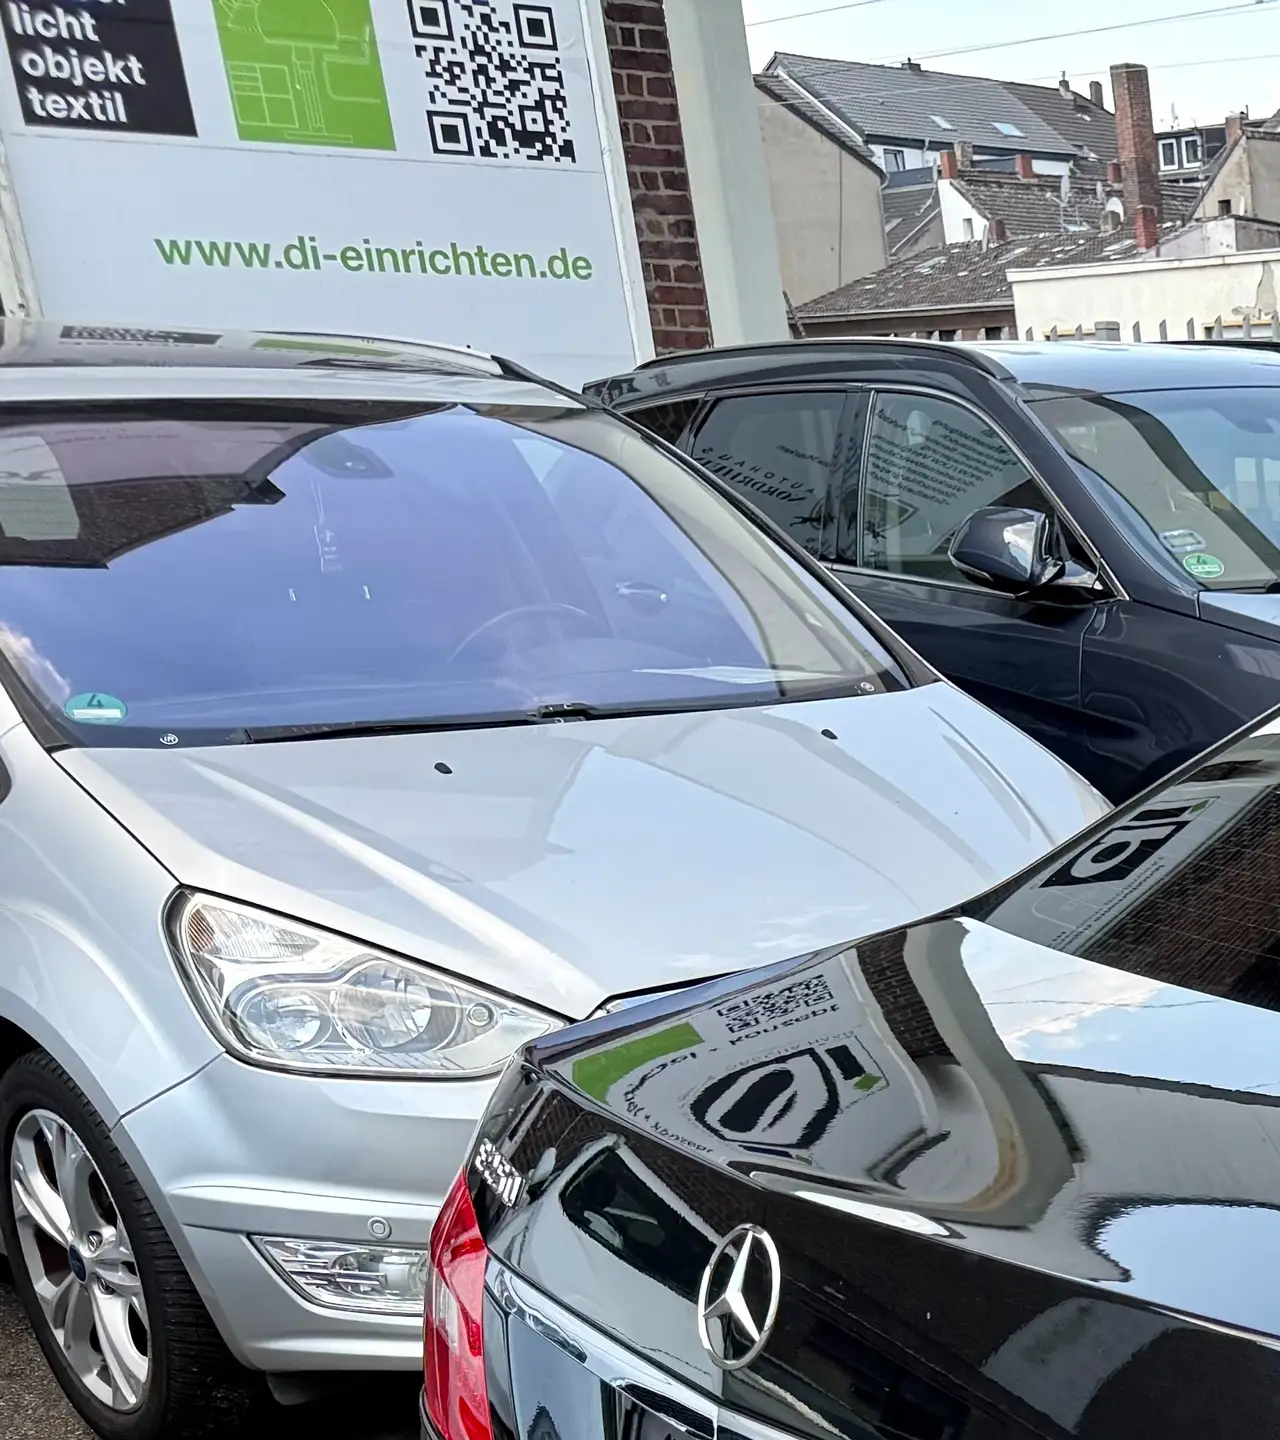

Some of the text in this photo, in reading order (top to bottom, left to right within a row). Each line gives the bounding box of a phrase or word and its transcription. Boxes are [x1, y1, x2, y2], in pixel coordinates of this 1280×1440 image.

[8, 2, 100, 42] licht
[20, 43, 147, 87] objekt
[25, 84, 128, 124] textil
[153, 235, 595, 280] www.di-einrichten.de
[87, 693, 105, 708] 4
